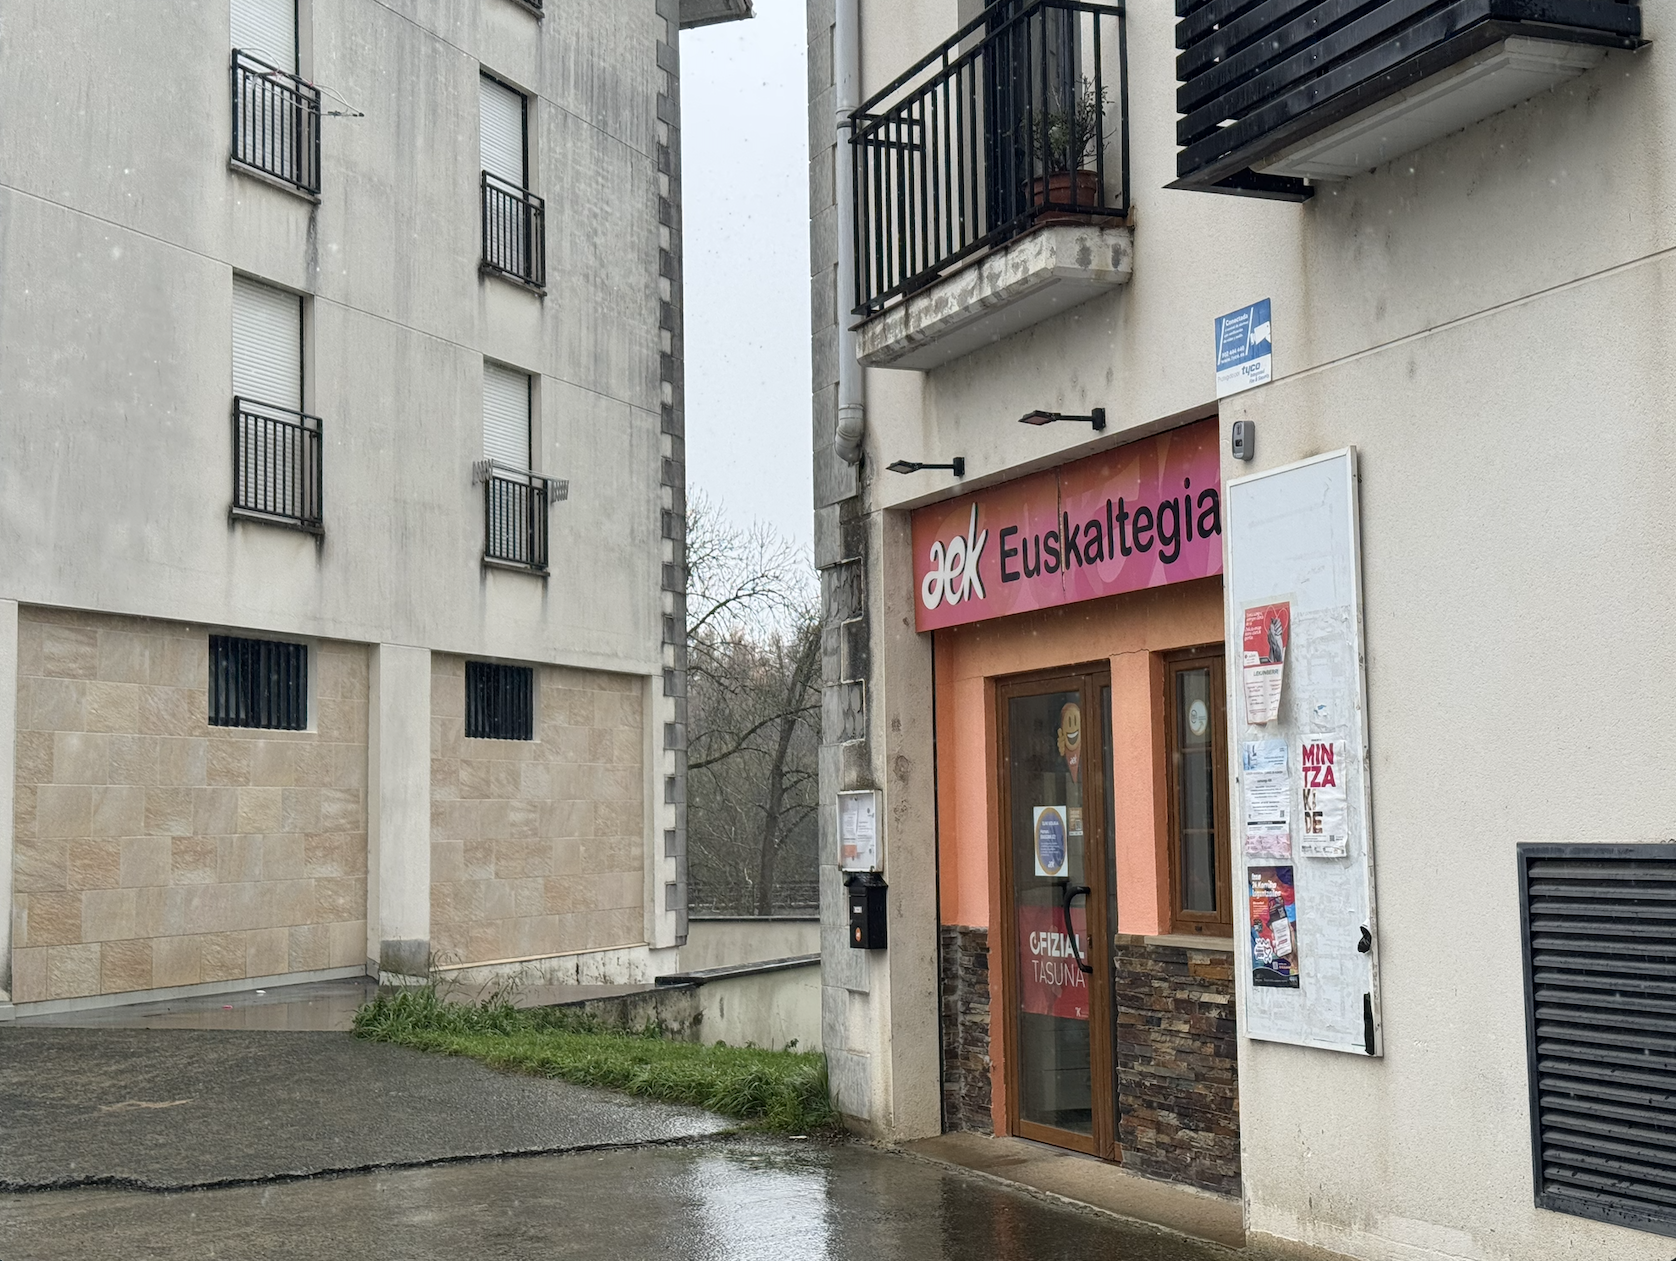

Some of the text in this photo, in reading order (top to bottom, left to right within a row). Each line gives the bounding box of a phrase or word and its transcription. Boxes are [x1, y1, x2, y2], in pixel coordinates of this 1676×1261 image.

[1225, 313, 1249, 327] Conectada
[1241, 362, 1261, 376] tyco
[921, 477, 1222, 611] aek Euskaltegia
[1302, 743, 1334, 766] MIN
[1302, 765, 1337, 788] TZA
[1304, 811, 1323, 834] DE
[1029, 931, 1085, 959] OFIZIAL
[1031, 959, 1086, 988] TASUNA
